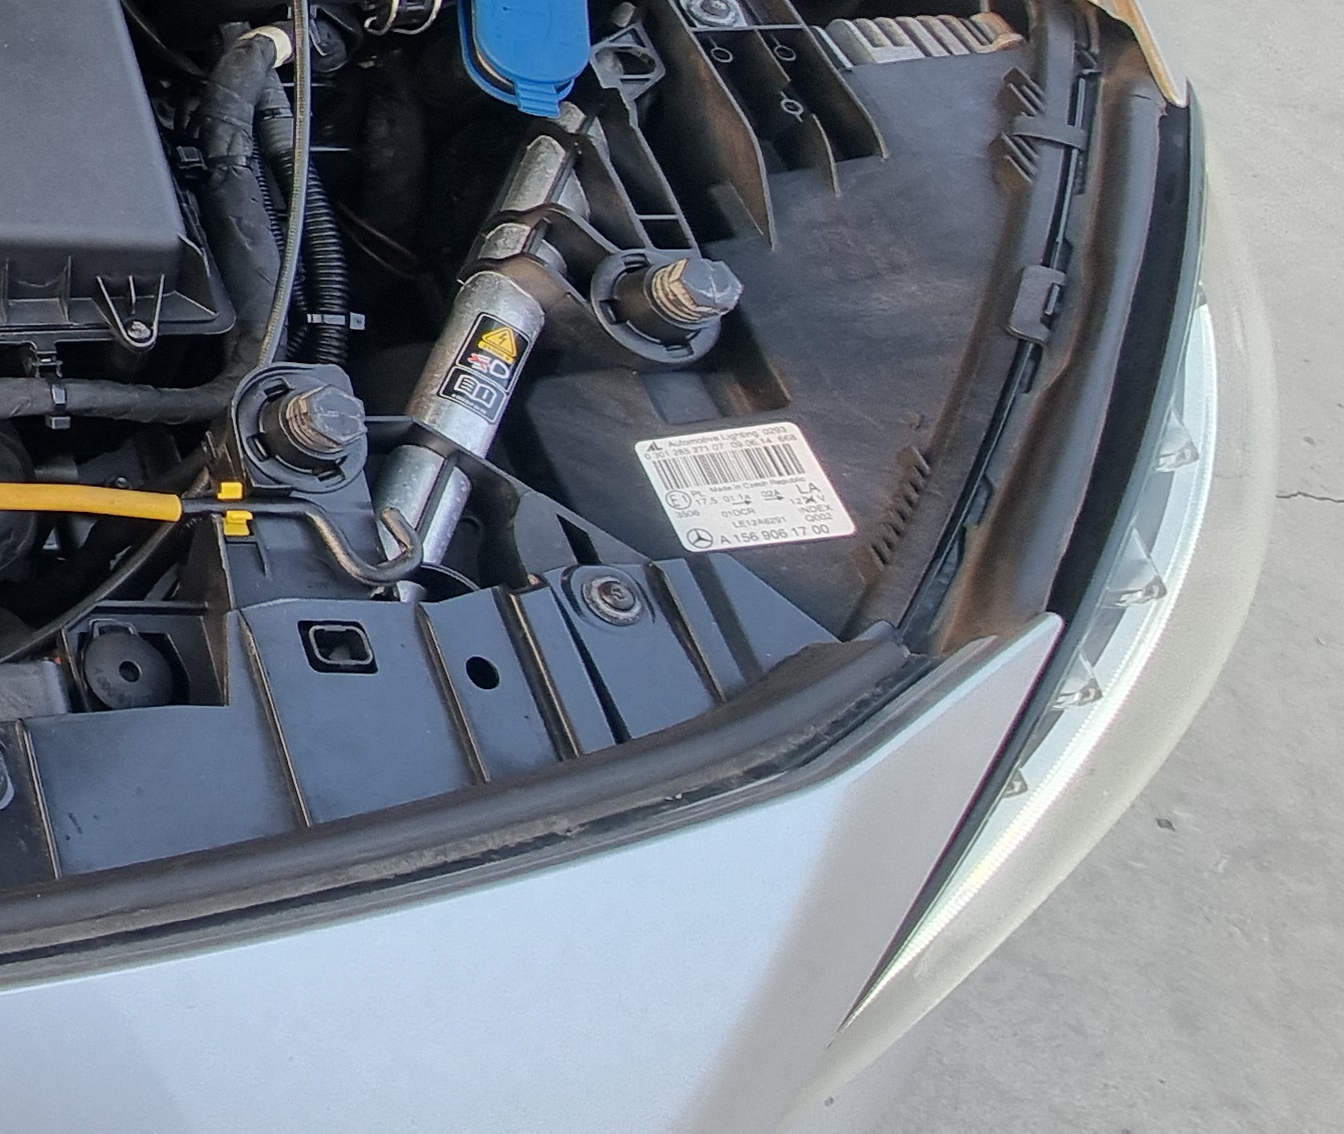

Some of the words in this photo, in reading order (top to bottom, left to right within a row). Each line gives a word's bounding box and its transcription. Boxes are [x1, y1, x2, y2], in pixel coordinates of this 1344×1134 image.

[668, 436, 720, 448] Automotive
[722, 431, 759, 442] Lighting
[770, 477, 806, 486] Republic
[796, 483, 821, 494] LA
[719, 536, 731, 545] A
[734, 532, 760, 543] 156
[761, 529, 789, 540] 906
[792, 528, 809, 536] 17
[811, 525, 831, 534] 00
